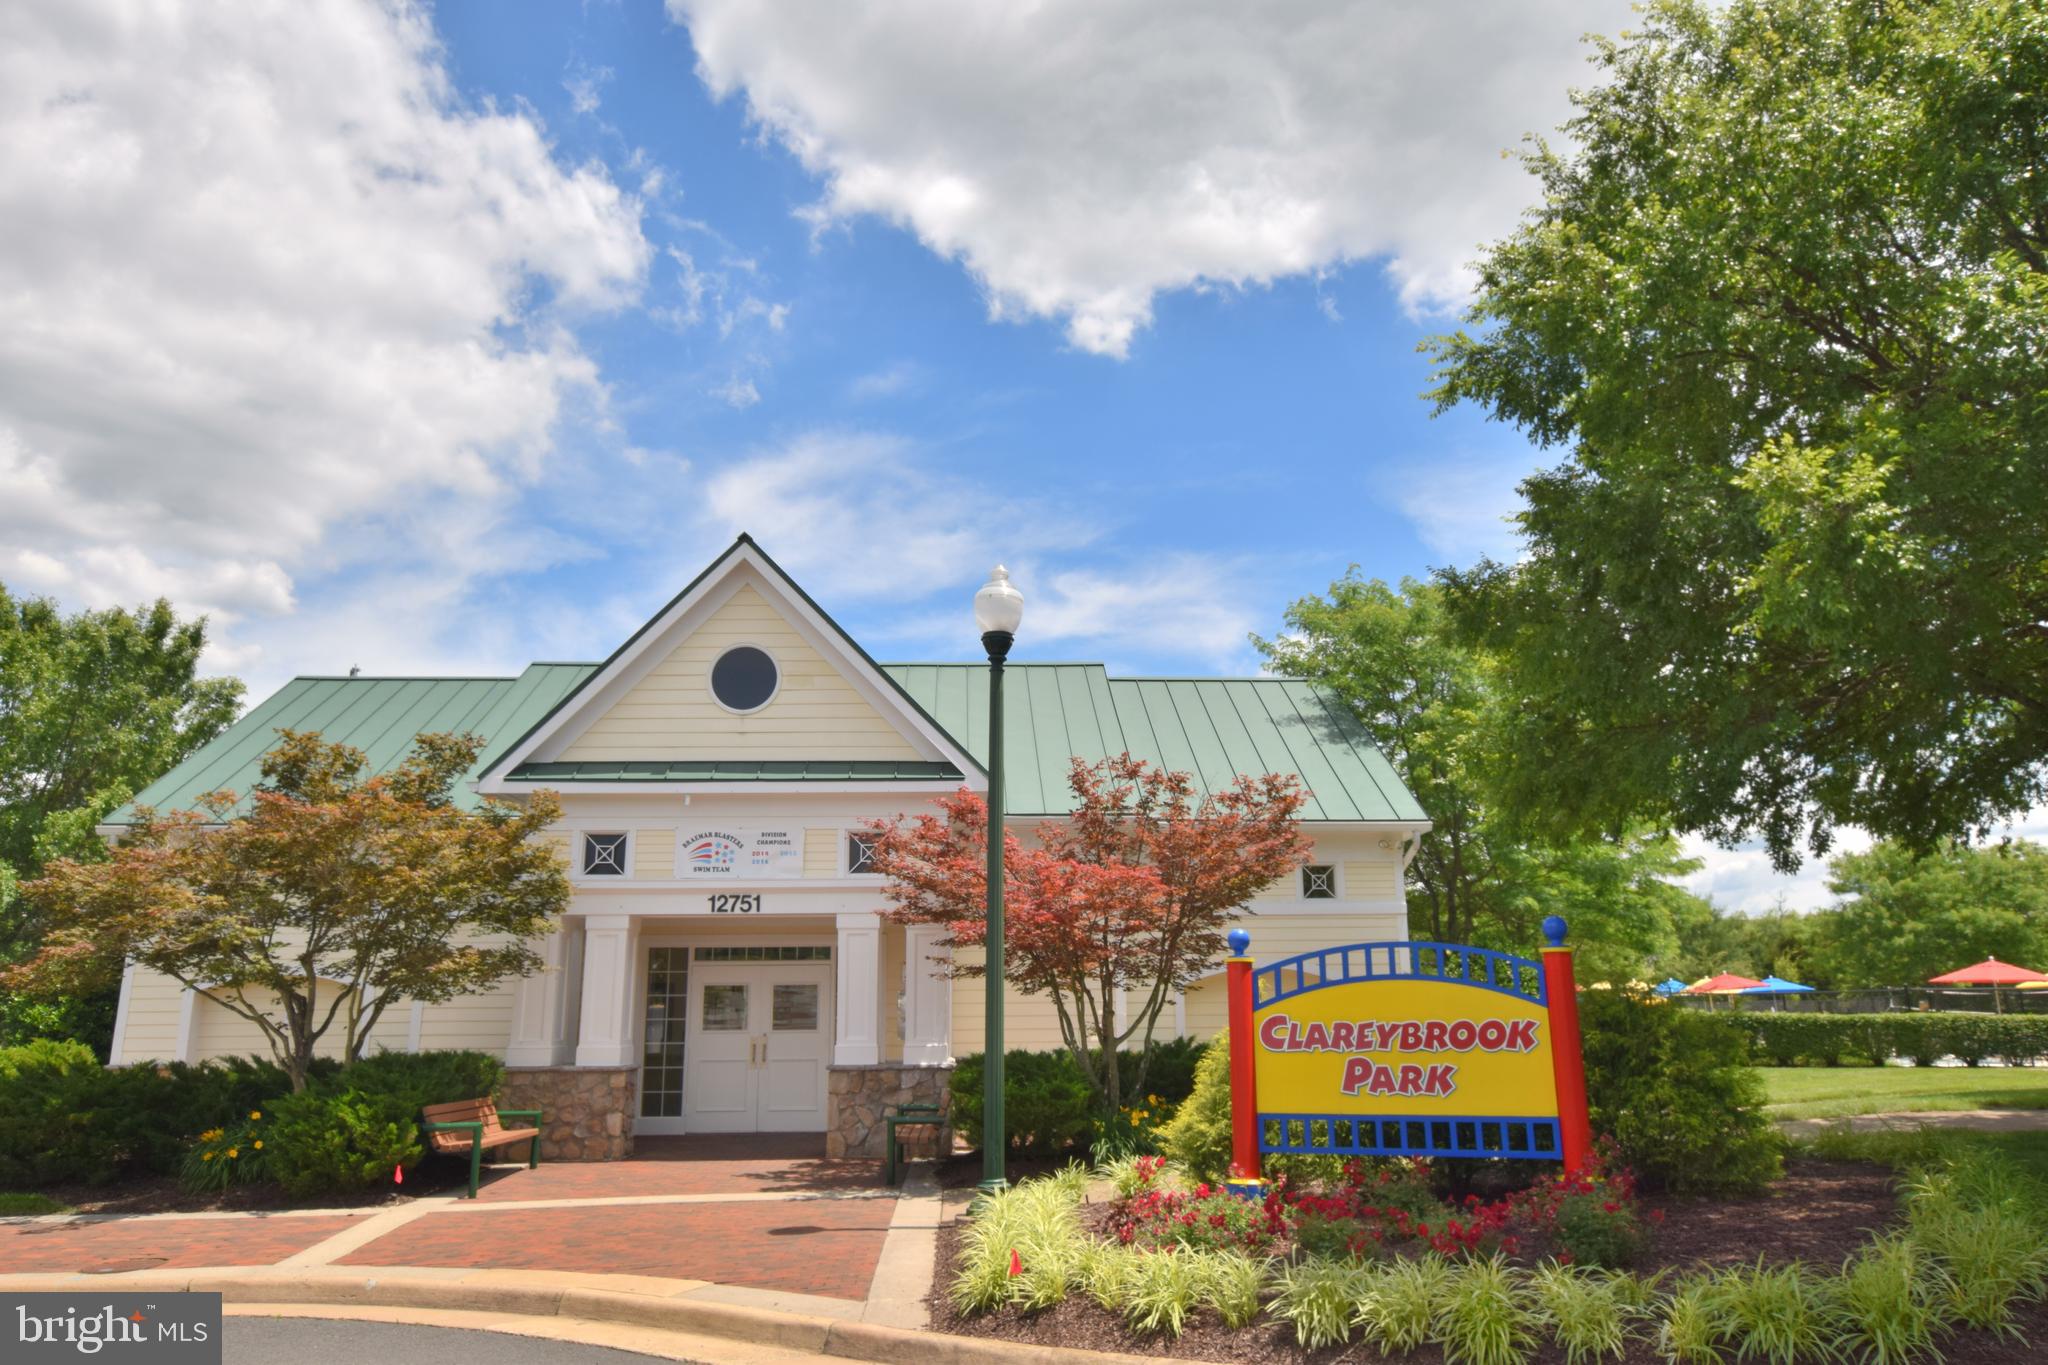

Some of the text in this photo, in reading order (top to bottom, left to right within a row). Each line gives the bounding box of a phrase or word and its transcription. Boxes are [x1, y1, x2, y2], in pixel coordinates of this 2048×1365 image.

[682, 832, 744, 849] BRAEMAR BLASTERS
[707, 894, 761, 913] 12751
[1259, 1014, 1541, 1053] CLAREYBROOK
[1340, 1056, 1457, 1097] PARK
